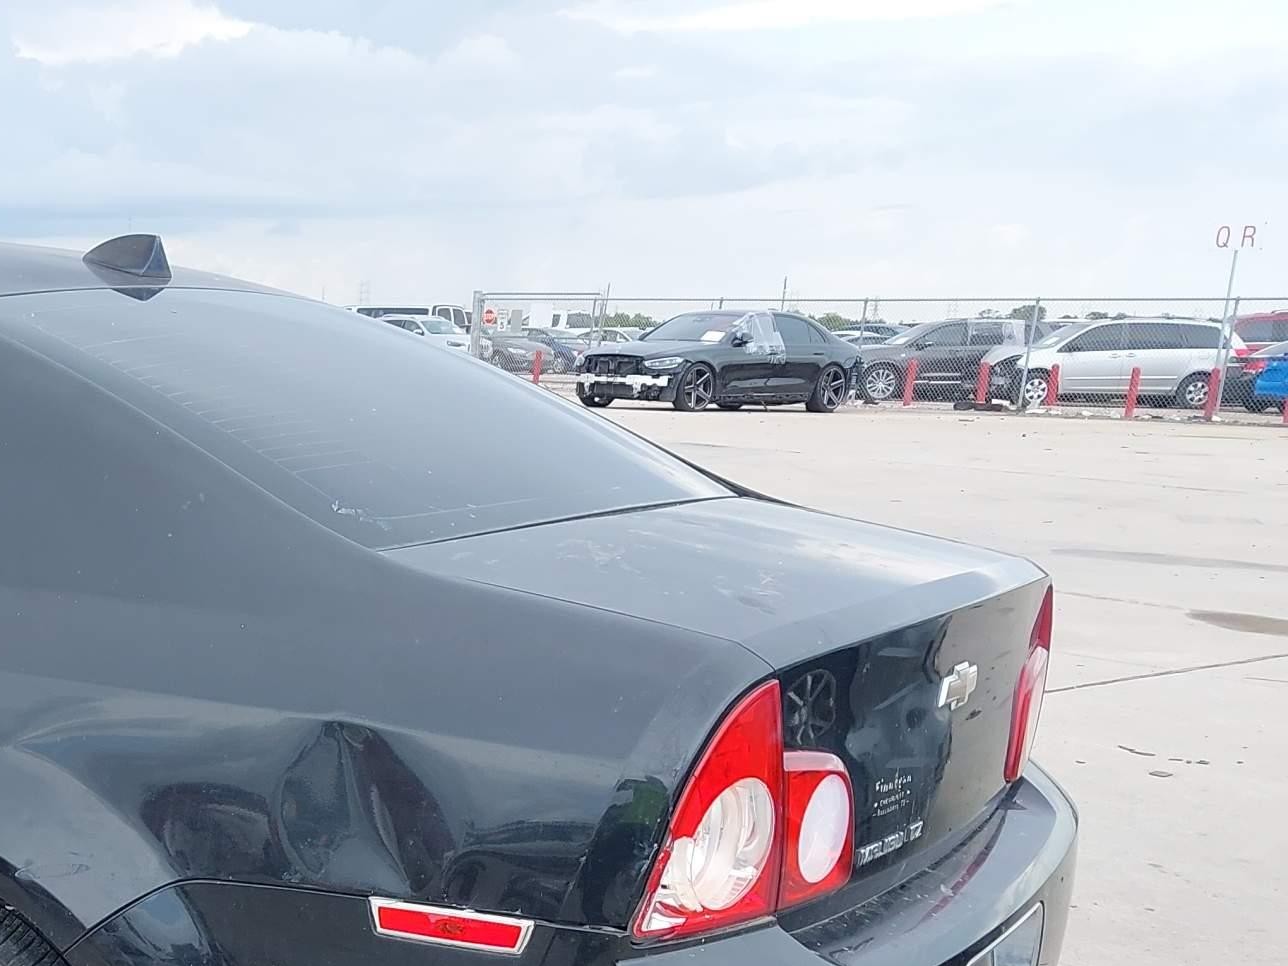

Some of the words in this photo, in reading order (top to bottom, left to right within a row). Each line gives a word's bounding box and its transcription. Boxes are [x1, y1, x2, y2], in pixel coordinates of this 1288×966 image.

[1215, 225, 1231, 248] Q
[1241, 225, 1257, 248] R
[856, 831, 904, 866] MALIBU
